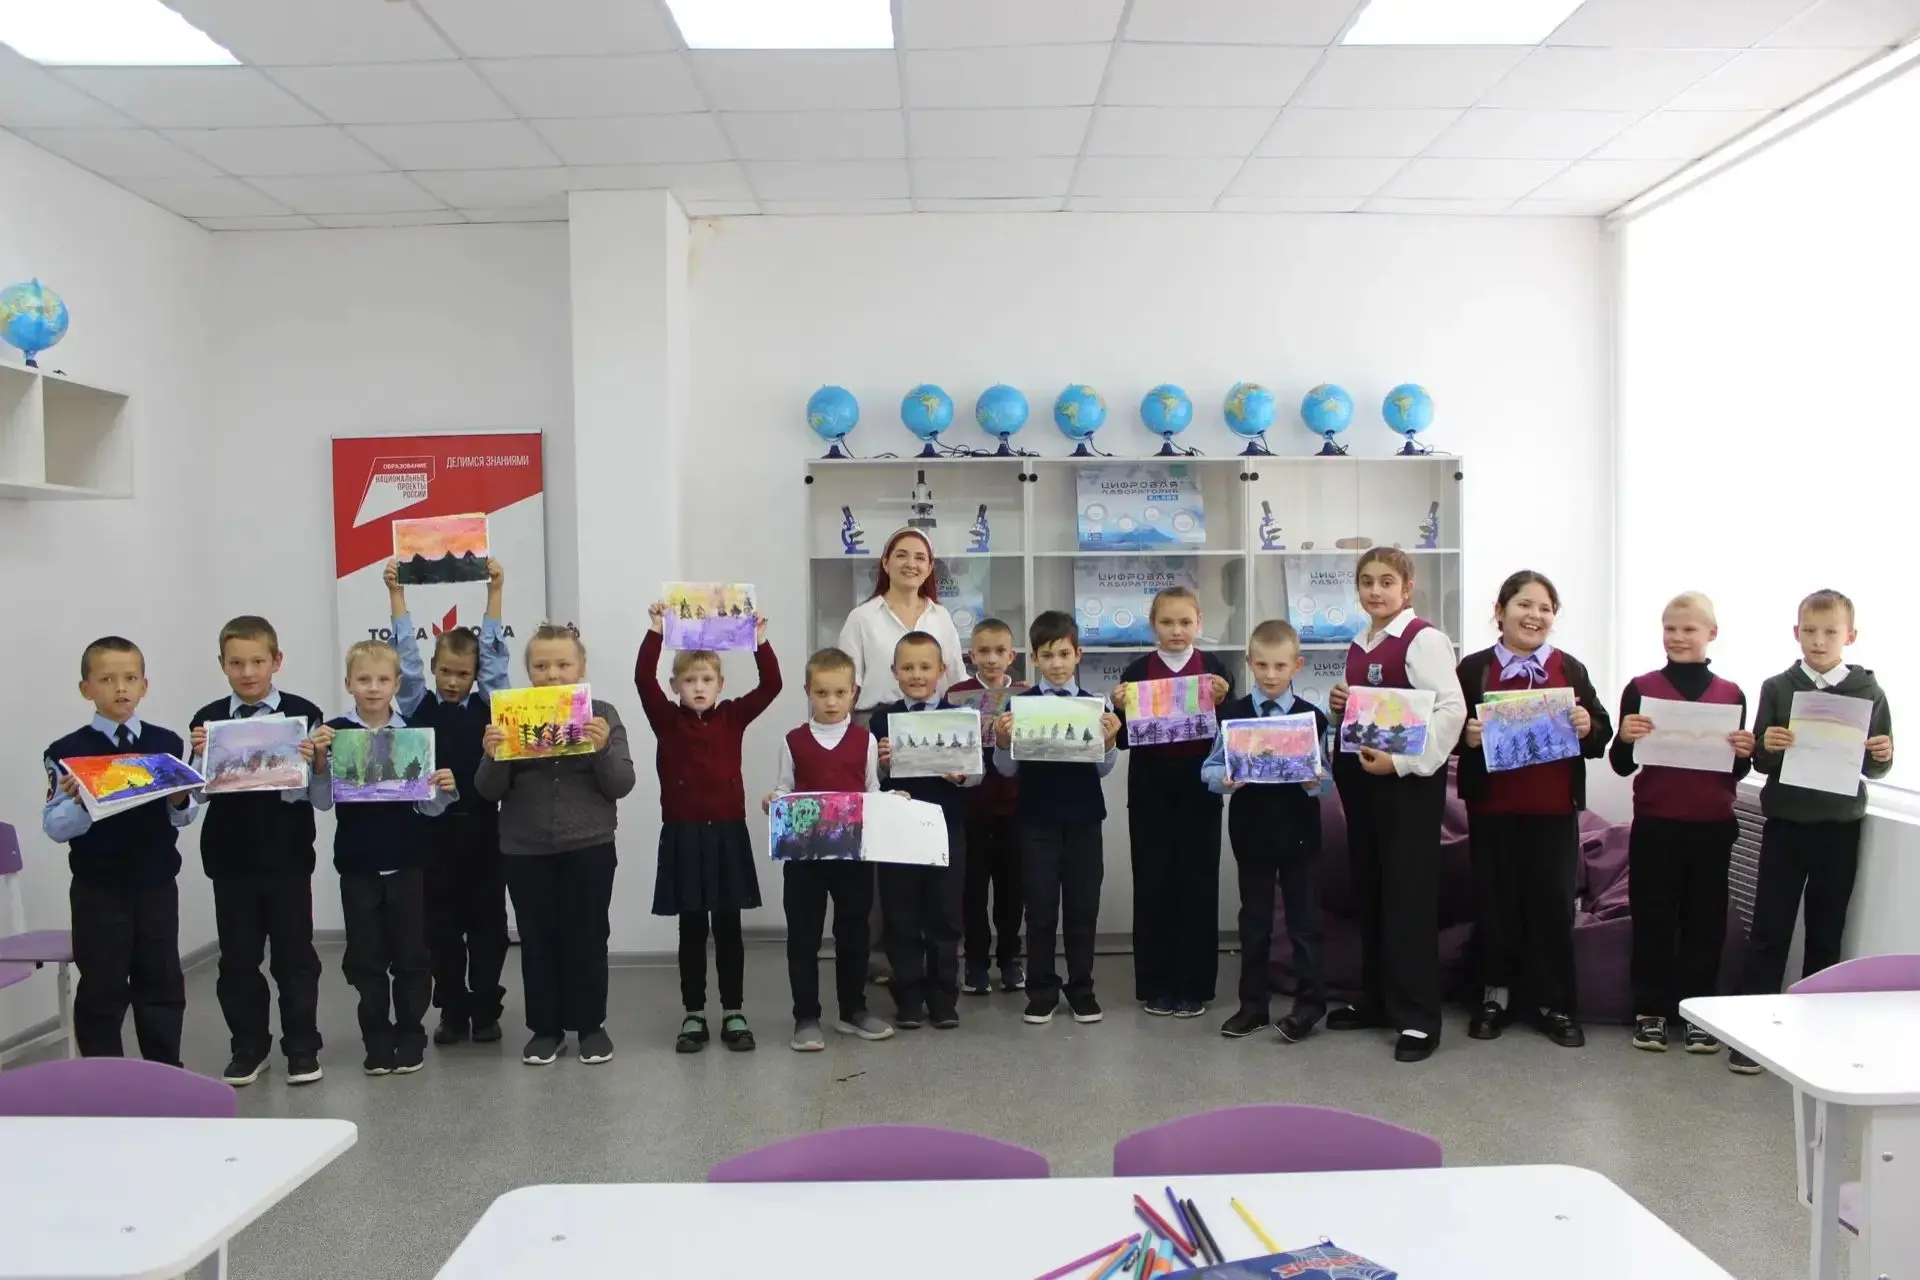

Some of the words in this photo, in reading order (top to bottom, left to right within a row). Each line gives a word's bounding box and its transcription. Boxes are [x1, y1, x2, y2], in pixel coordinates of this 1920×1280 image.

[382, 462, 427, 470] ОБРАЗОВАНИЕ
[446, 456, 484, 469] ДЕЛИМСЯ
[486, 455, 529, 467] ЗНАНИЯМИ
[375, 474, 426, 483] НАЦИОНАЛЬНЫЕ
[397, 482, 426, 491] ПРОЕКТЫ
[1101, 480, 1178, 489] ЦИФРОВАЯ
[403, 490, 426, 499] РОССИИ
[1098, 572, 1175, 581] ЦИФРОВАЯ
[1310, 571, 1355, 579] ЦИФРО
[368, 627, 428, 641] ТОА
